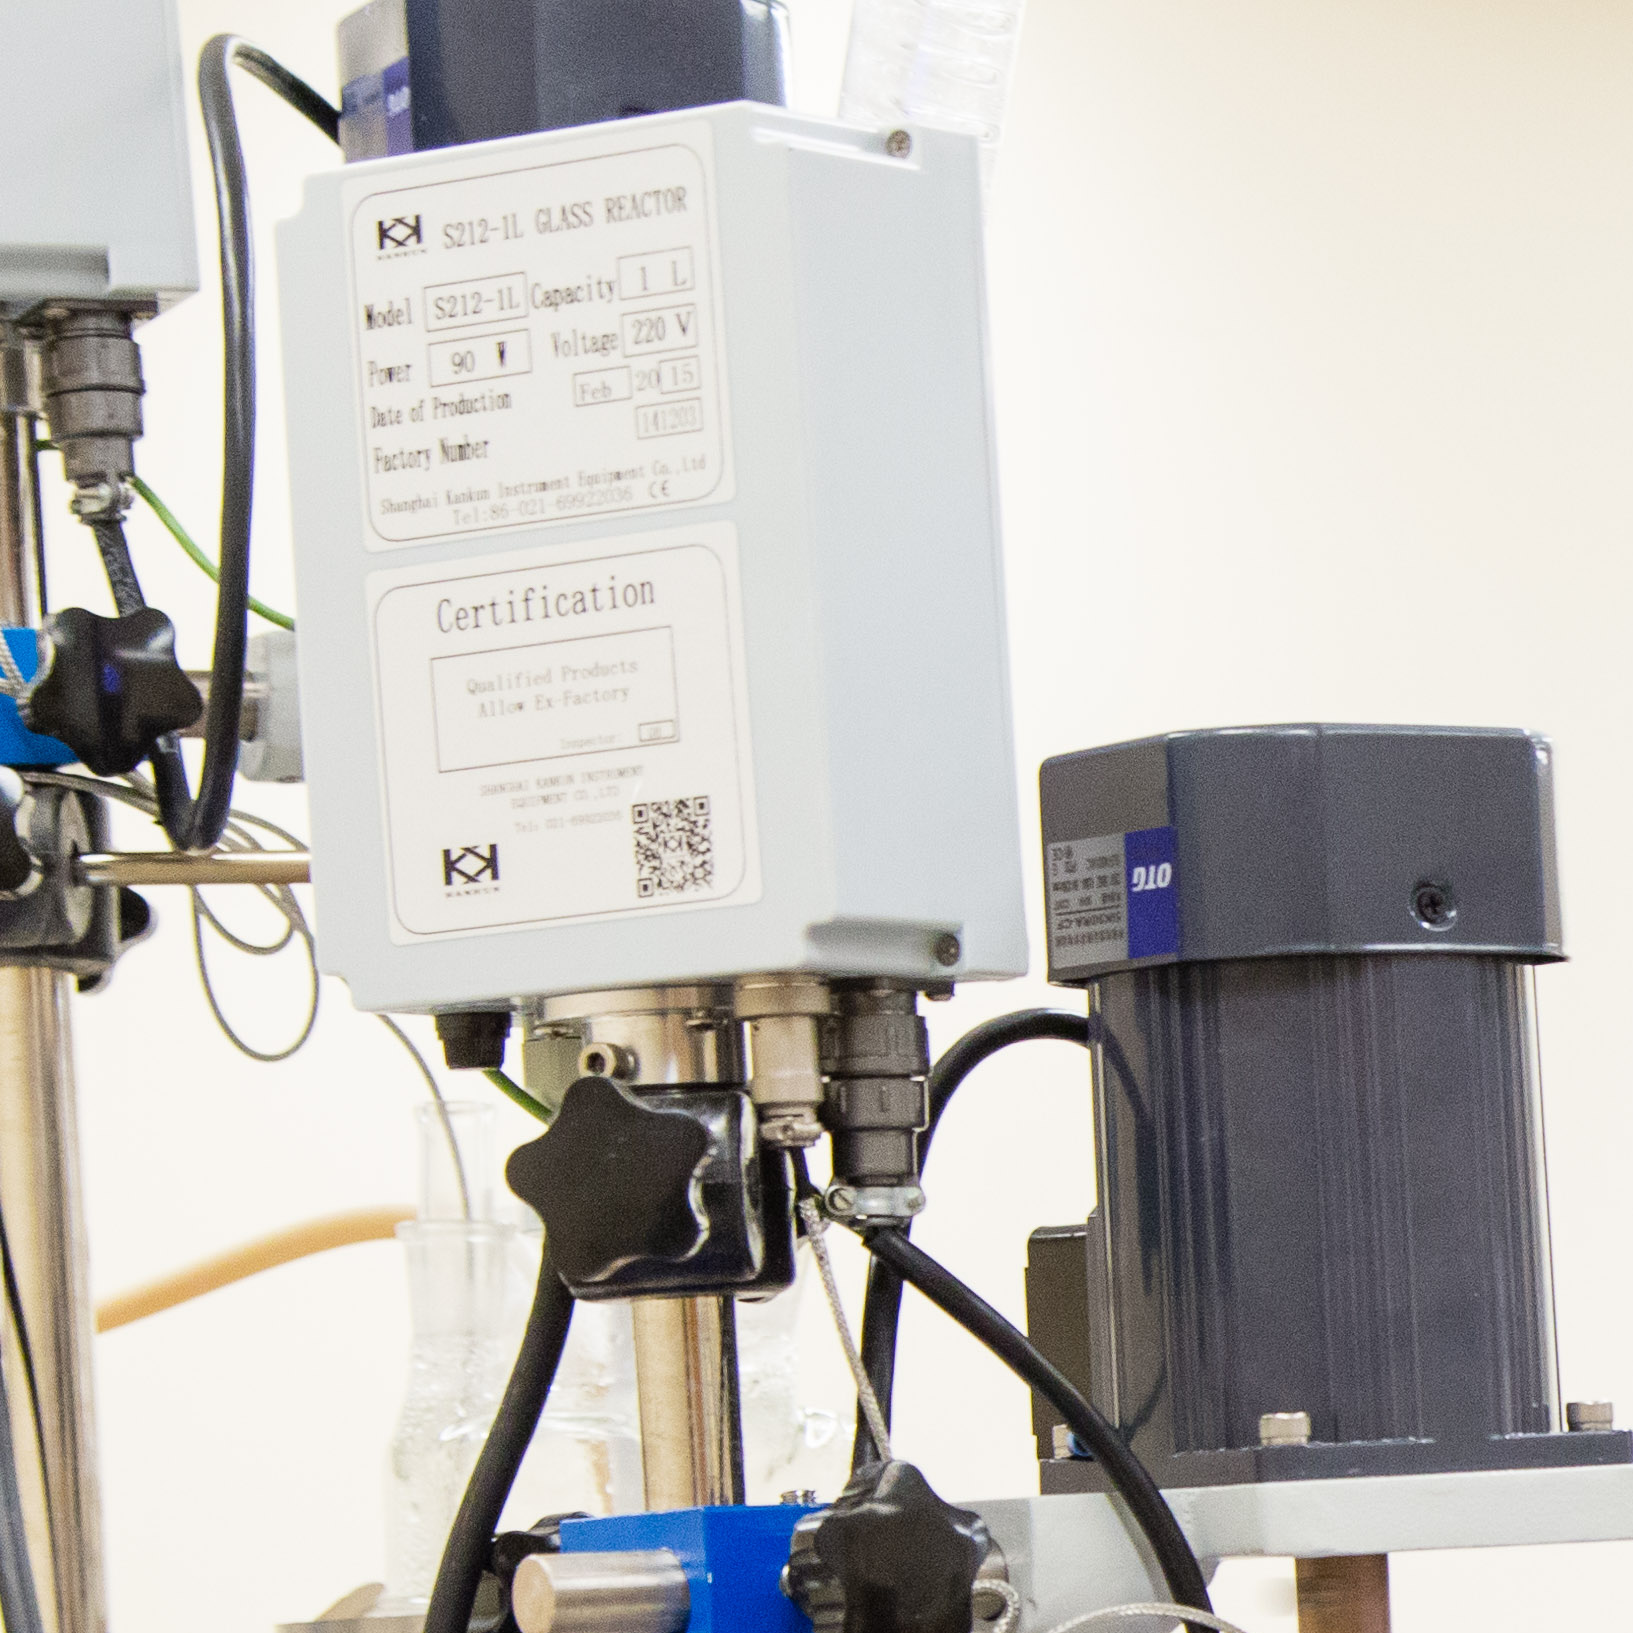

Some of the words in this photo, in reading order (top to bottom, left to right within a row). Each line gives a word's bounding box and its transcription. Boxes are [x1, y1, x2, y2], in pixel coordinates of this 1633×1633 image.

[441, 212, 524, 251] S212-1L
[535, 201, 594, 235] GLASS
[605, 186, 688, 224] REACTOR
[364, 298, 414, 331] Model
[434, 286, 521, 320] S212-1L
[531, 273, 617, 311] Capacity
[368, 360, 413, 387] Power
[450, 349, 476, 375] 90
[551, 331, 619, 360] Voltage
[632, 318, 666, 345] 220
[675, 311, 693, 337] V
[371, 404, 403, 429] Date
[408, 399, 425, 422] of
[432, 389, 513, 420] Production
[579, 380, 613, 403] Feb
[635, 368, 660, 392] 20
[668, 364, 694, 387] 15
[373, 444, 431, 474] Factory
[439, 434, 490, 463] Number
[380, 492, 438, 516] Shanghai
[498, 474, 570, 499] Instrument
[577, 464, 645, 491] Equipment
[437, 575, 656, 634] Certification
[466, 670, 552, 697] Qualified
[561, 659, 639, 681] Products
[478, 700, 526, 719] Allow
[1131, 862, 1173, 893] OTG
